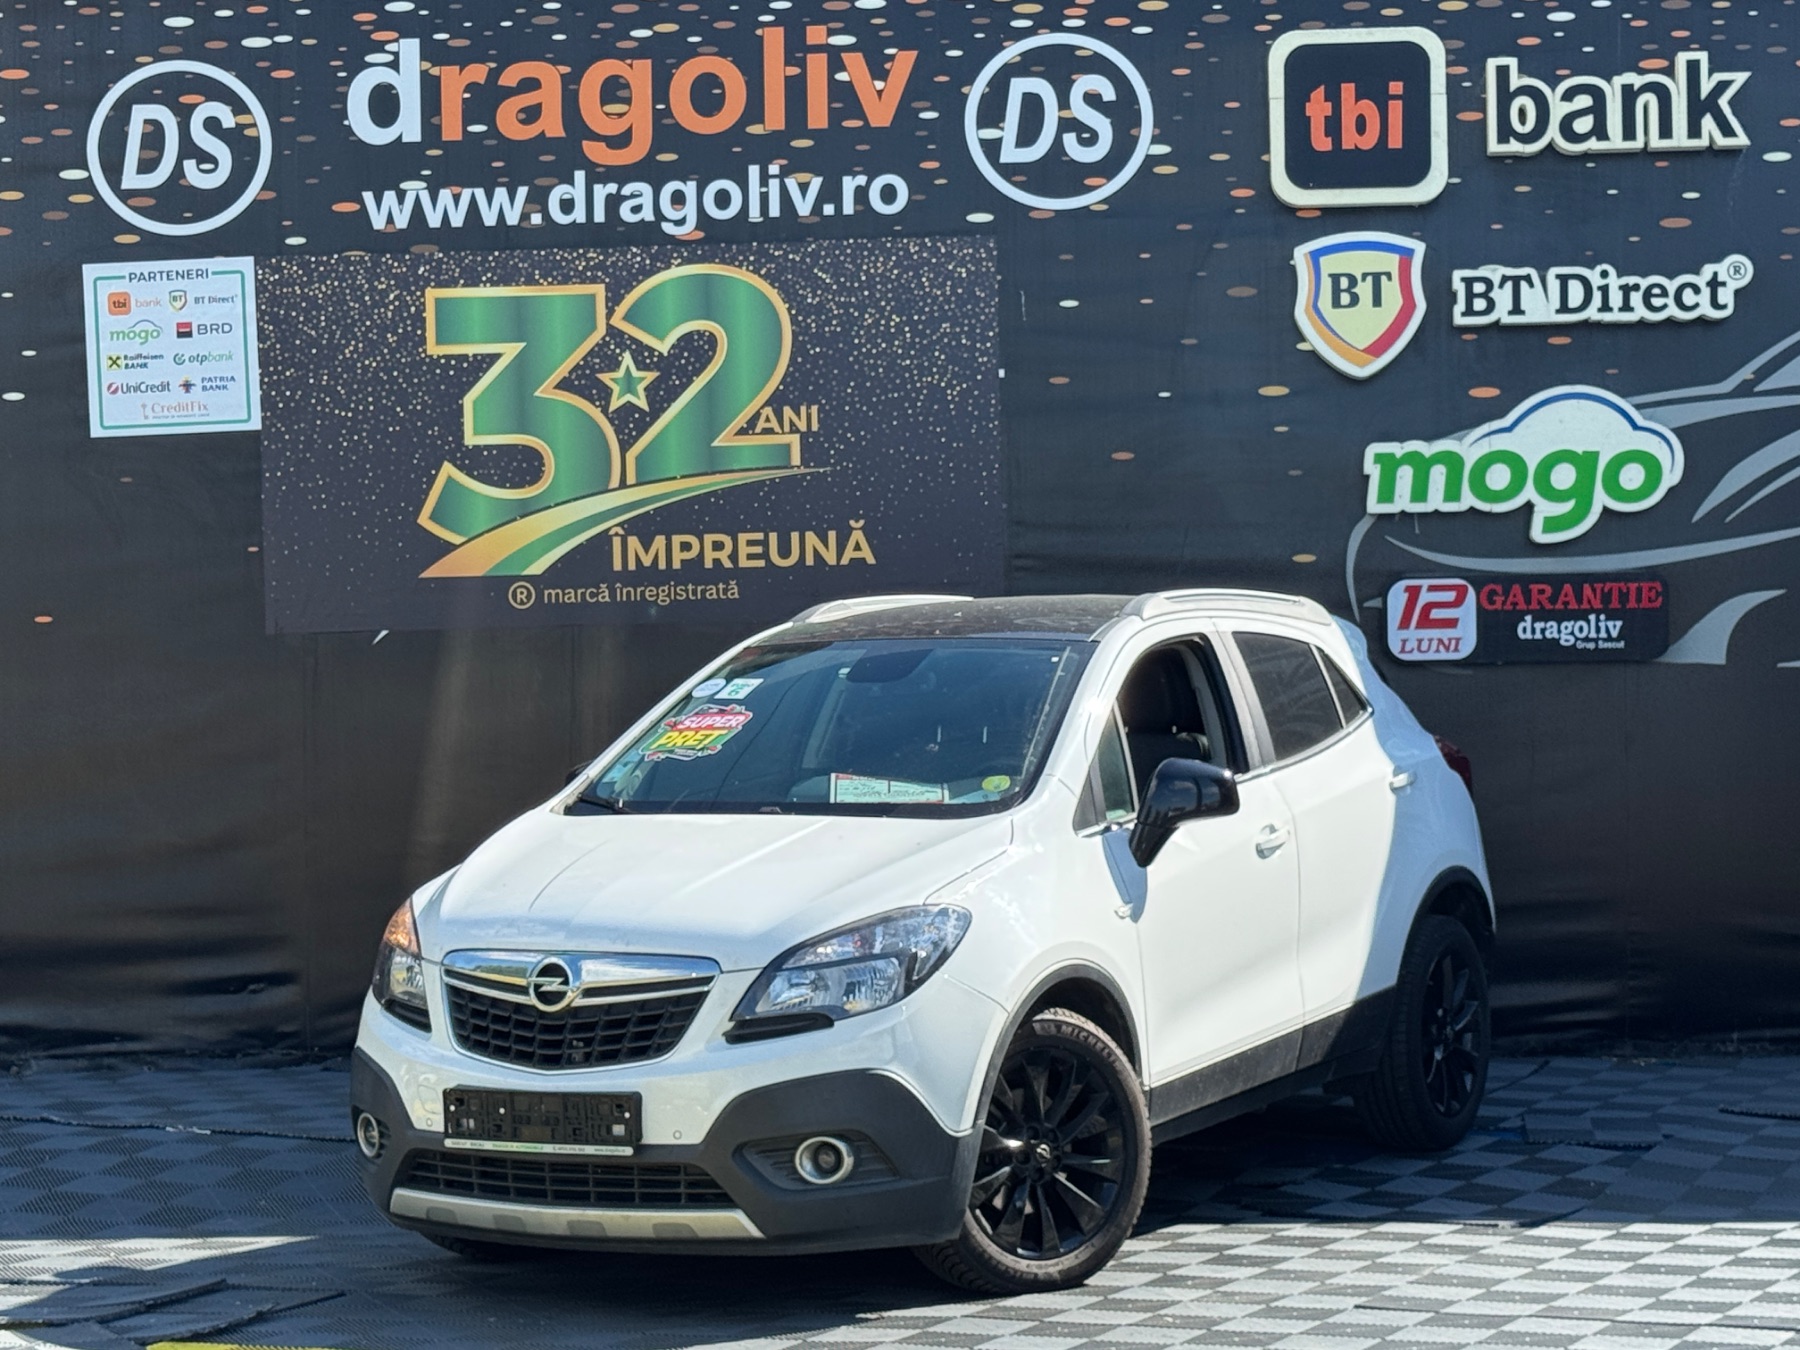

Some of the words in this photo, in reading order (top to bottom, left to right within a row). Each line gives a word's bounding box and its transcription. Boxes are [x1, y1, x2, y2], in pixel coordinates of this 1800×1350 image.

[347, 25, 919, 166] dragoliv
[1490, 52, 1749, 152] bank
[999, 73, 1117, 164] DS
[1305, 81, 1404, 152] tbi
[121, 101, 236, 190] DS
[362, 164, 910, 236] www.dragoliv.ro
[128, 268, 209, 283] PARTENERI
[112, 298, 127, 309] tbi
[135, 297, 162, 308] bank
[172, 294, 184, 303] BT
[194, 296, 206, 305] BT
[1328, 271, 1392, 310] BT
[1460, 273, 1534, 317] BT
[109, 328, 161, 345] mogo
[197, 322, 233, 335] BRD
[123, 353, 164, 362] Raiffeisen
[188, 351, 234, 366] otpbank
[120, 381, 171, 395] UniCredit
[201, 375, 236, 384] PATRIA
[201, 384, 229, 392] BANK
[151, 401, 209, 414] CreditFix
[417, 263, 801, 546] 32
[754, 405, 820, 433] ANI
[1373, 448, 1664, 535] mogo
[607, 519, 877, 572] ÎMPREUNĂ
[543, 582, 610, 604] marcă
[615, 580, 739, 607] înregistrată
[1479, 581, 1663, 611] GARANTIE
[1397, 584, 1468, 631] 12
[1516, 613, 1623, 646] dragoliv
[1398, 636, 1462, 655] LUNI
[676, 714, 746, 730] SUPER
